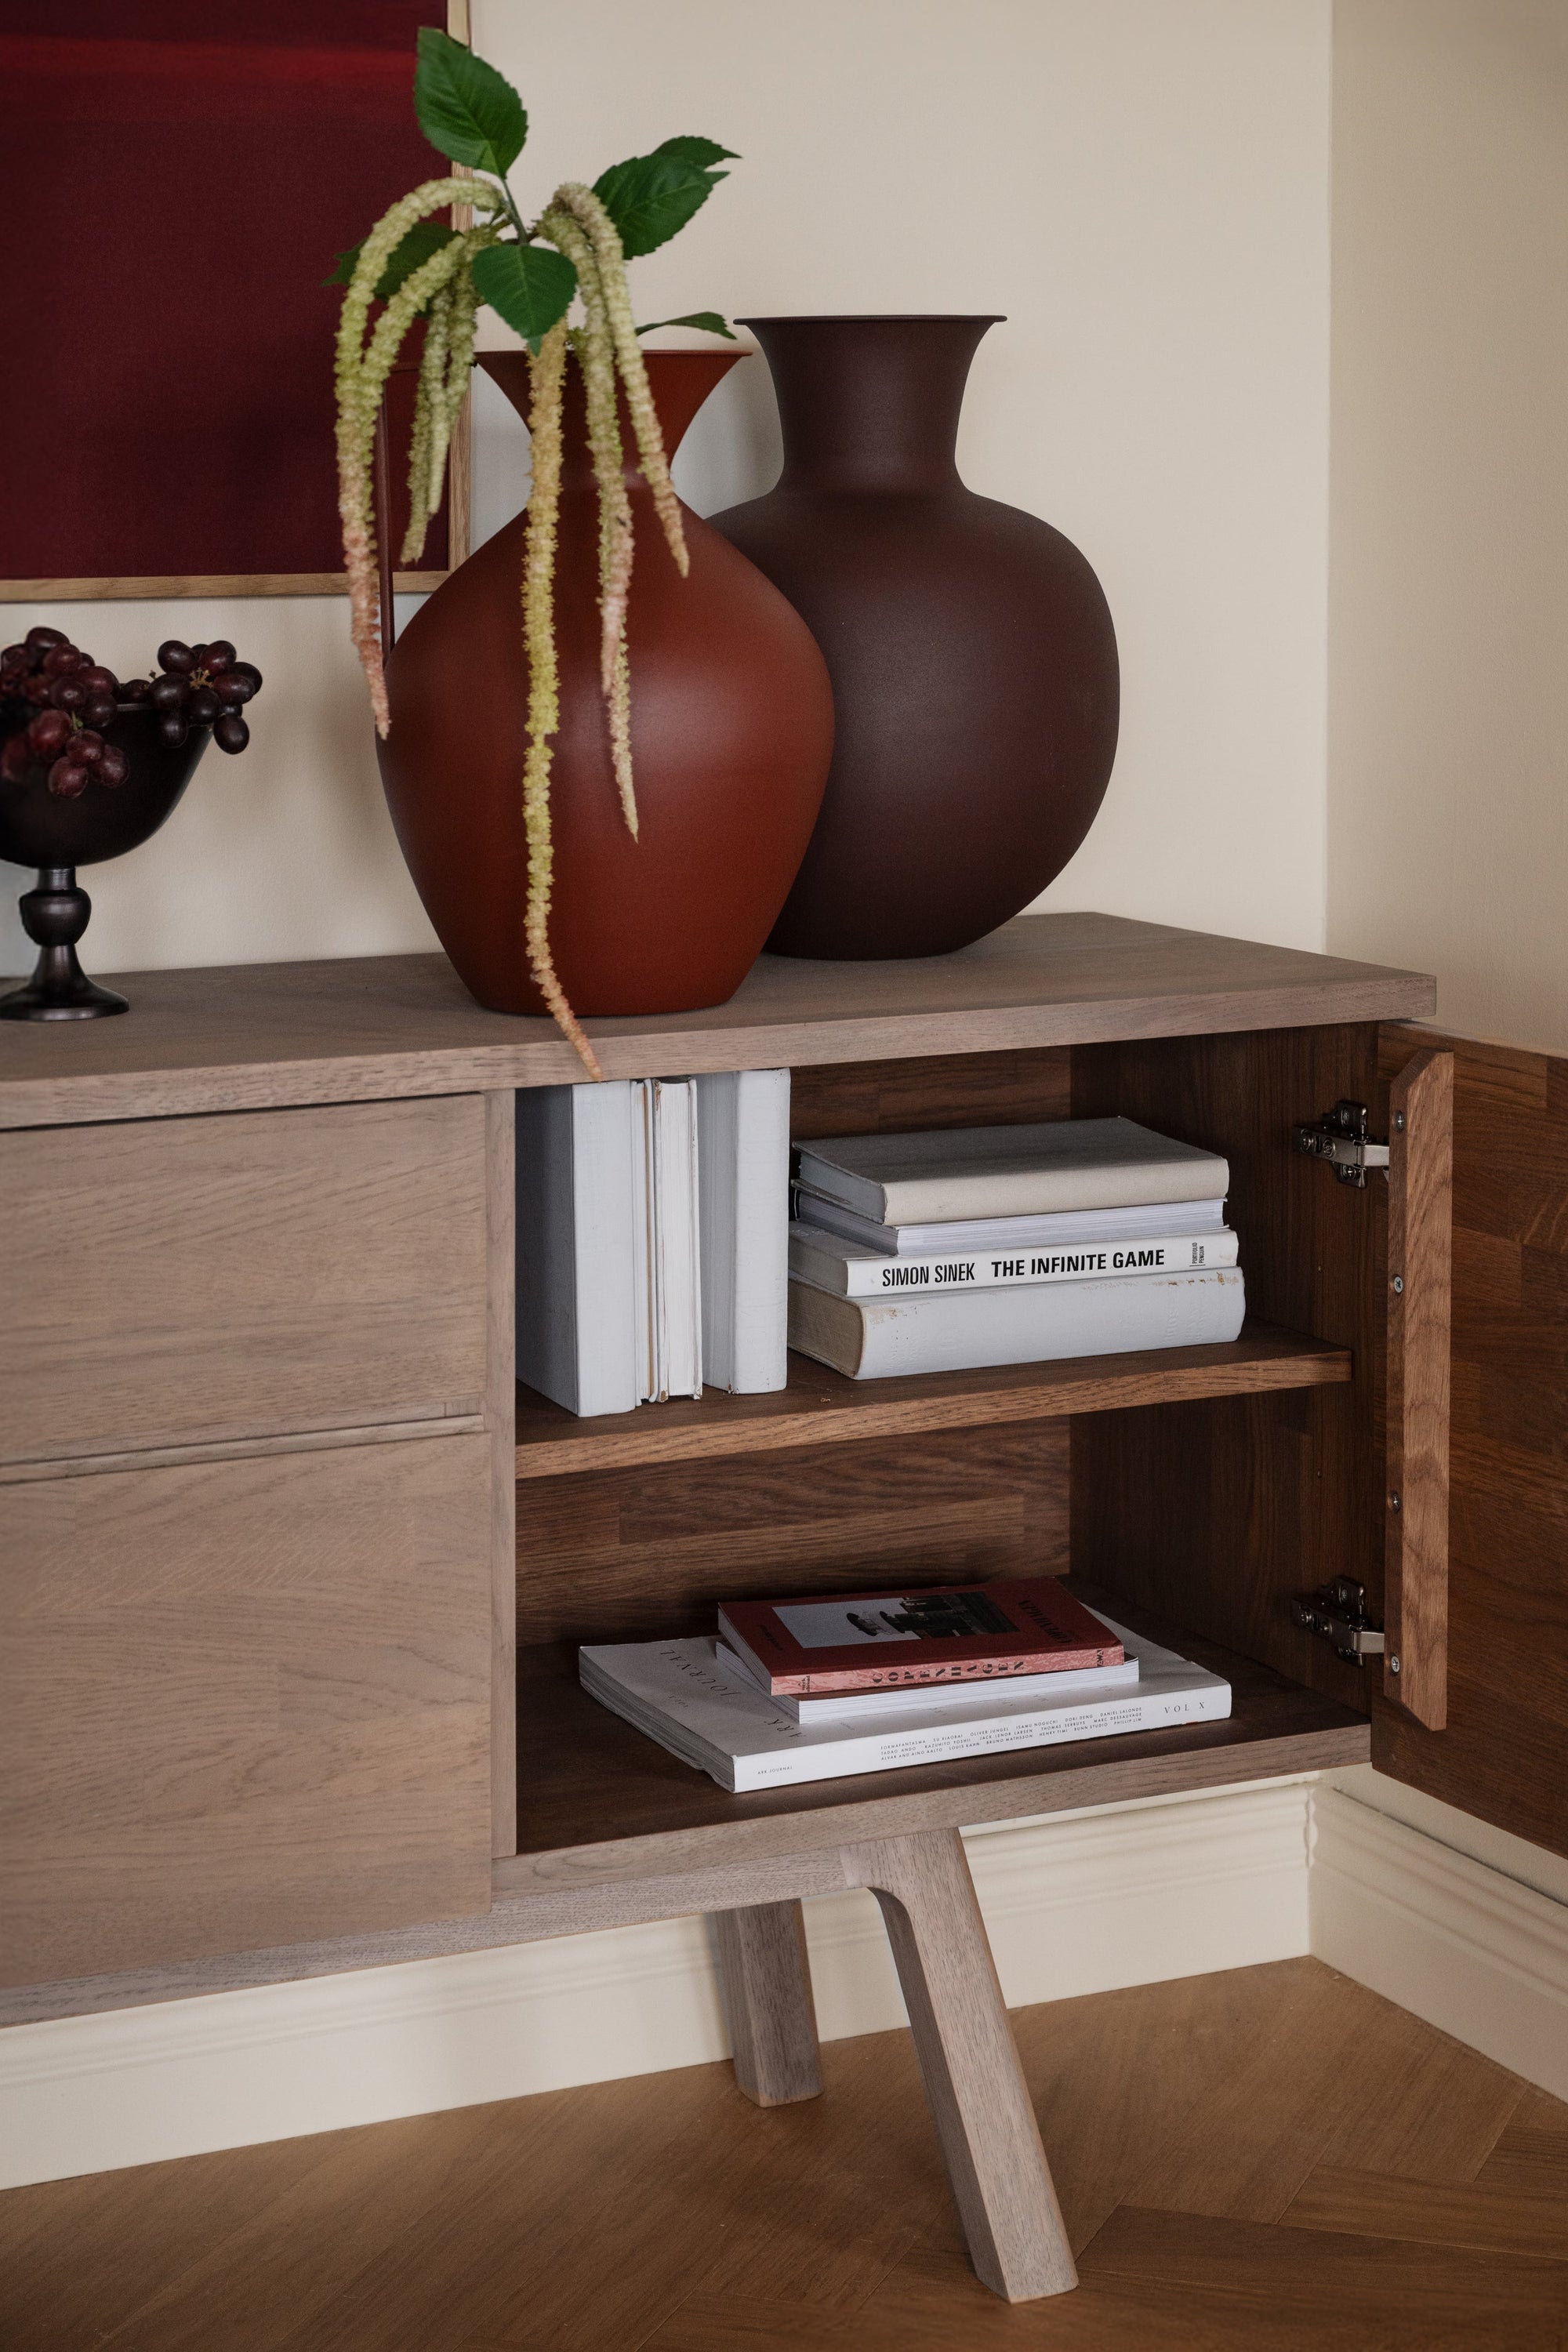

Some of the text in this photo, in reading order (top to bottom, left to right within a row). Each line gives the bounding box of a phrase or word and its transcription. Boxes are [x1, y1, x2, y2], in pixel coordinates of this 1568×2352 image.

[882, 1262, 975, 1287] SIMON SINEK
[991, 1249, 1165, 1278] THE INFINITE GAME
[660, 1649, 741, 1696] JOURNAL
[872, 1661, 1025, 1684] COPENHAGEN
[1164, 1704, 1190, 1714] VOL
